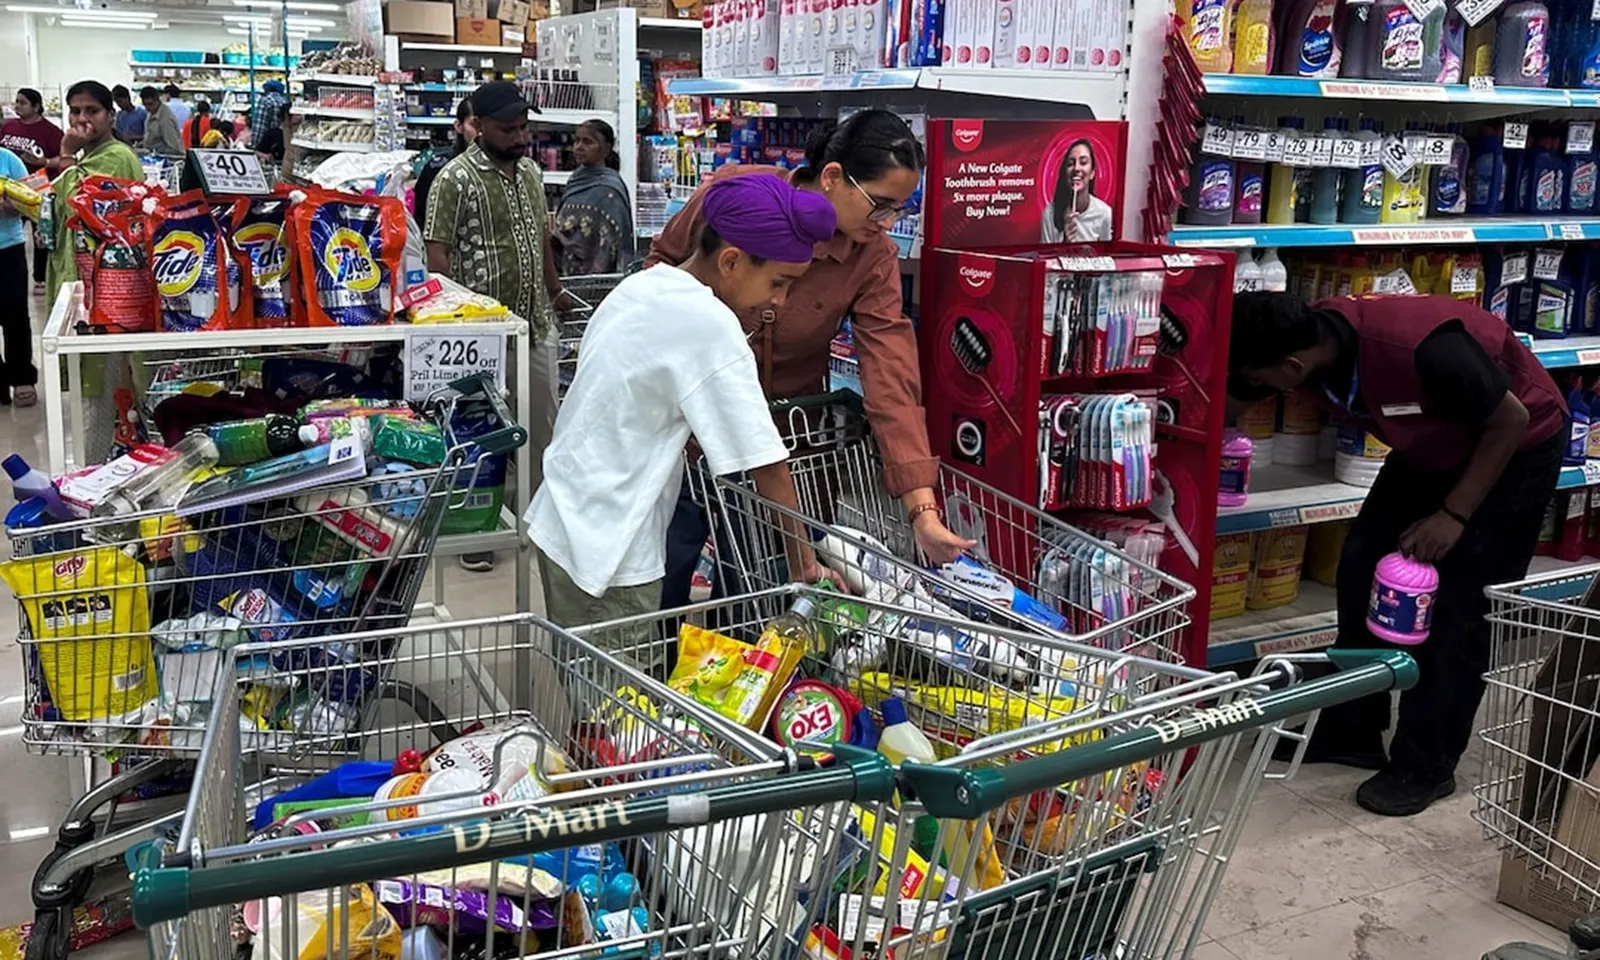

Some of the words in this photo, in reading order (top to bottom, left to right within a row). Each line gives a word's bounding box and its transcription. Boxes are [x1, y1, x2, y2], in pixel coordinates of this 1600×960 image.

[955, 129, 980, 138] Colgate
[958, 163, 966, 173] A
[968, 163, 988, 173] New
[989, 163, 1022, 176] Colgate
[944, 176, 995, 188] Toothbrush
[998, 177, 1035, 187] removes
[953, 192, 964, 203] 5x
[966, 192, 989, 201] more
[991, 190, 1024, 203] plaque.
[966, 206, 984, 219] Buy
[986, 205, 1010, 217] Now!
[154, 248, 199, 278] Tide
[332, 247, 372, 282] Tide
[960, 266, 993, 280] Colgate
[439, 340, 478, 366] 226
[411, 369, 429, 380] Pril
[433, 369, 458, 380] Lime
[953, 575, 1001, 592] Panasonic
[791, 702, 833, 739] EXO
